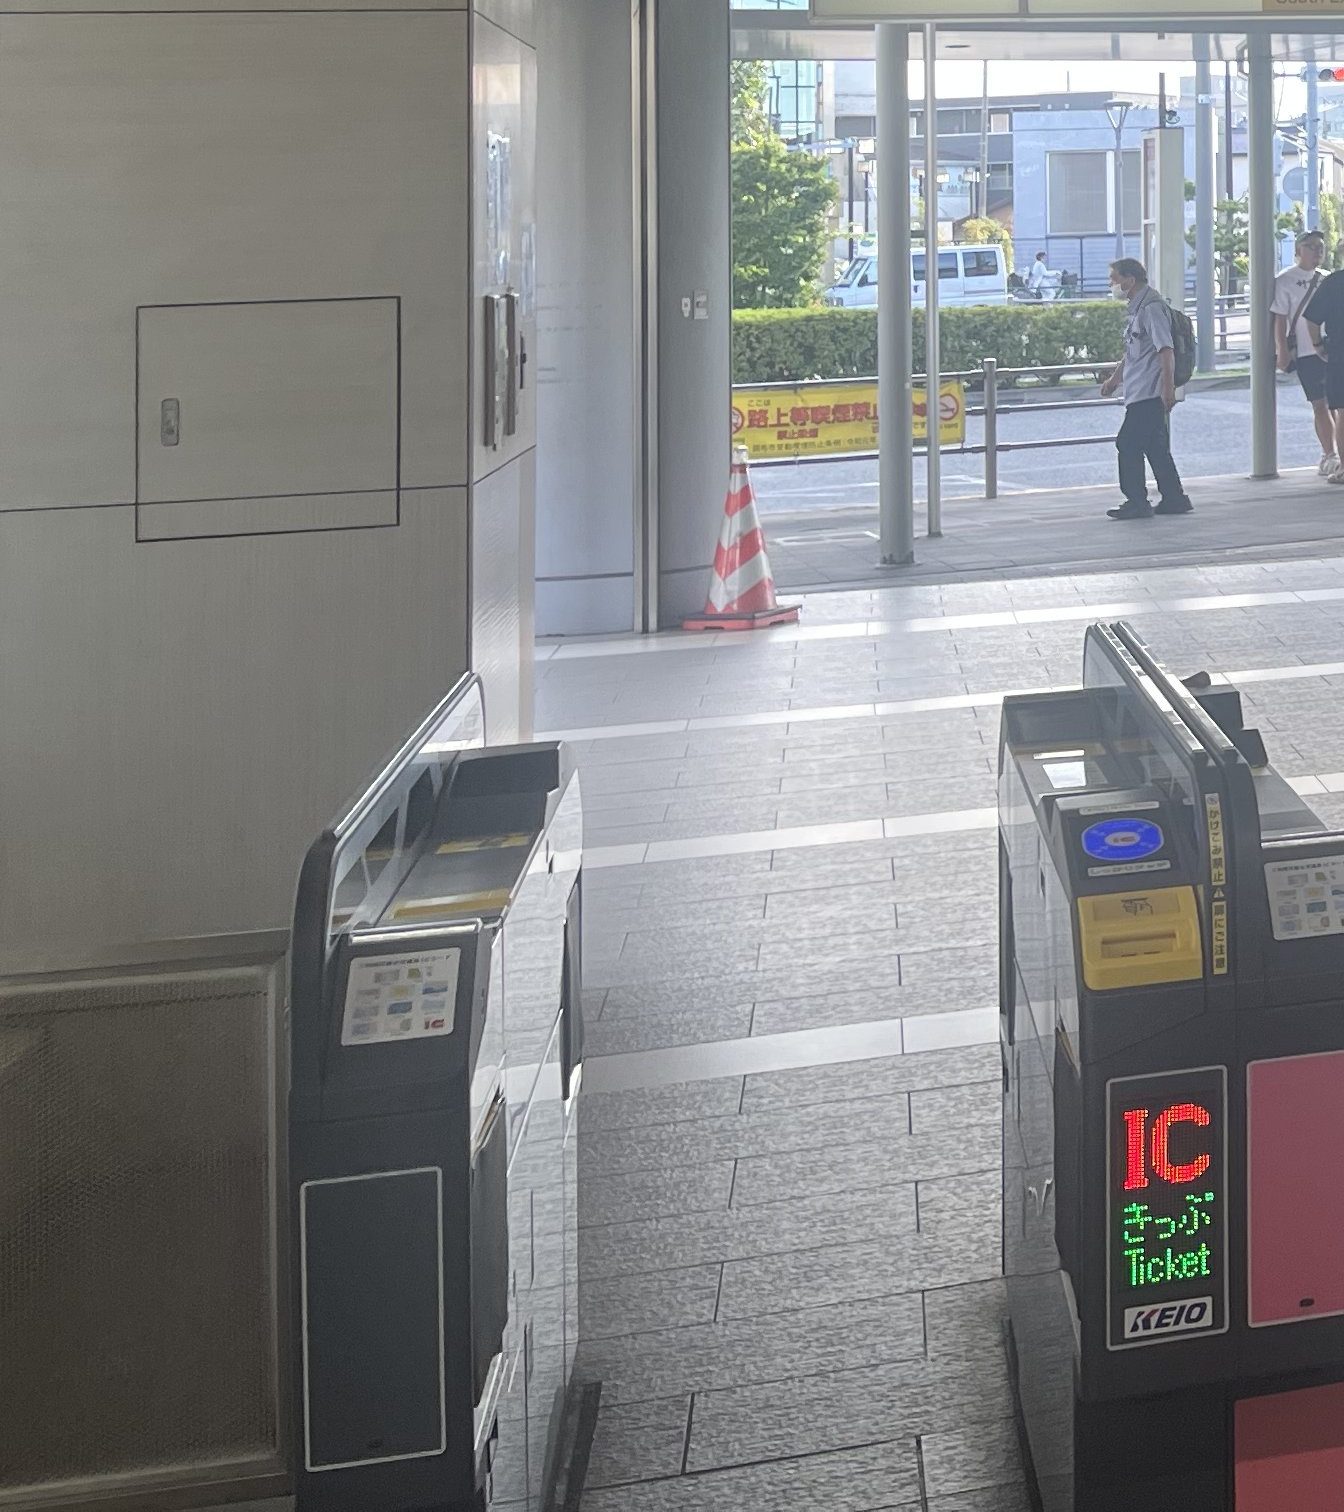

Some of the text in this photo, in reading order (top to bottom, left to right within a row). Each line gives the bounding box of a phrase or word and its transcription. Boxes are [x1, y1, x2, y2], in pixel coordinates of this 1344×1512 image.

[747, 399, 771, 407] ここは
[1208, 808, 1225, 884] かけこみ禁止
[1123, 1103, 1211, 1190] IC
[1124, 1192, 1214, 1243] きっぷ
[1124, 1243, 1210, 1286] Ticket
[1130, 1302, 1207, 1333] KEIO
